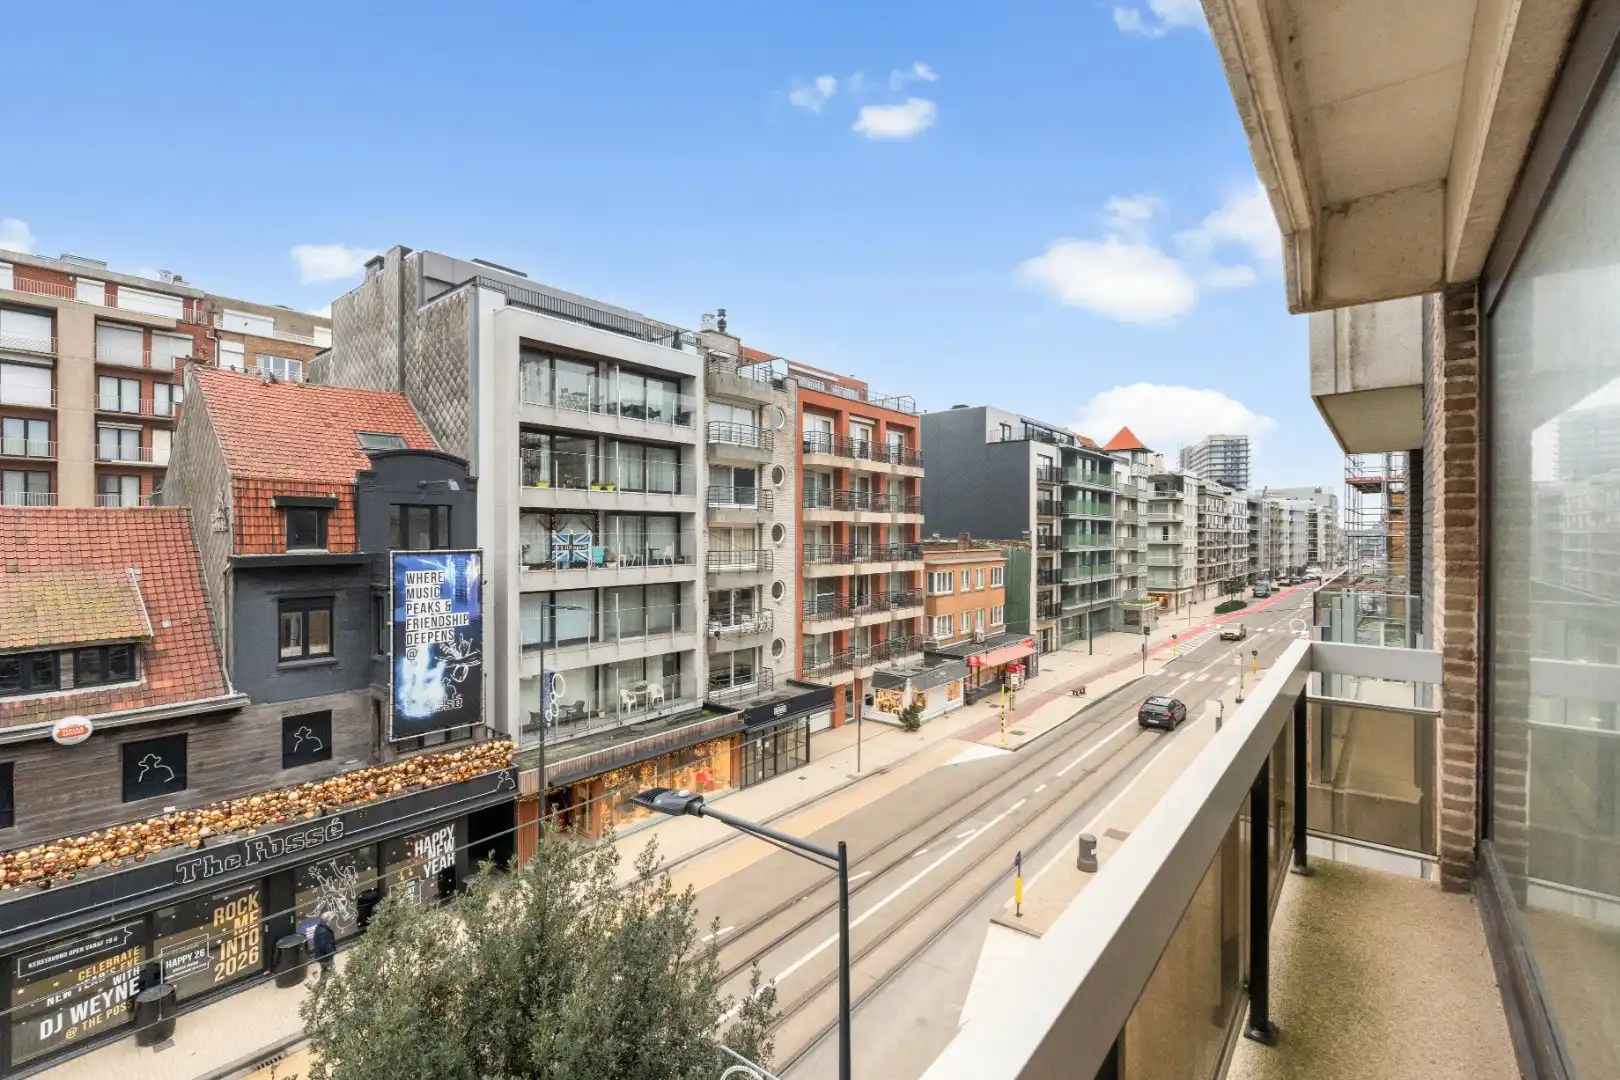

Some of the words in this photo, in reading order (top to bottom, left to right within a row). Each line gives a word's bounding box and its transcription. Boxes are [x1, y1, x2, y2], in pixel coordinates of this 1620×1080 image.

[406, 572, 444, 585] WHERE
[406, 587, 440, 600] MUSIC
[406, 601, 441, 615] PEAKS
[445, 600, 452, 612] &
[406, 613, 469, 630] FRIENDSHIP
[406, 630, 454, 646] DEEPENS
[406, 648, 418, 660] @
[175, 854, 242, 885] The
[245, 817, 344, 867] Possé
[414, 823, 456, 858] HAPPY
[427, 837, 455, 860] NEW
[213, 890, 260, 927] ROCK
[234, 909, 259, 936] ME
[28, 951, 68, 969] KERSTAVOND
[68, 946, 84, 956] OPEN
[85, 940, 104, 951] VANAF
[220, 927, 259, 961] INTO
[77, 945, 140, 982] CELEBRATE
[165, 951, 193, 969] HAPPY
[194, 948, 206, 959] 26
[214, 945, 259, 982] 2026
[112, 966, 140, 986] WITH
[40, 1012, 63, 1040] DJ
[70, 975, 140, 1026] WEYNE
[65, 1026, 78, 1040] @
[82, 1013, 103, 1031] THE
